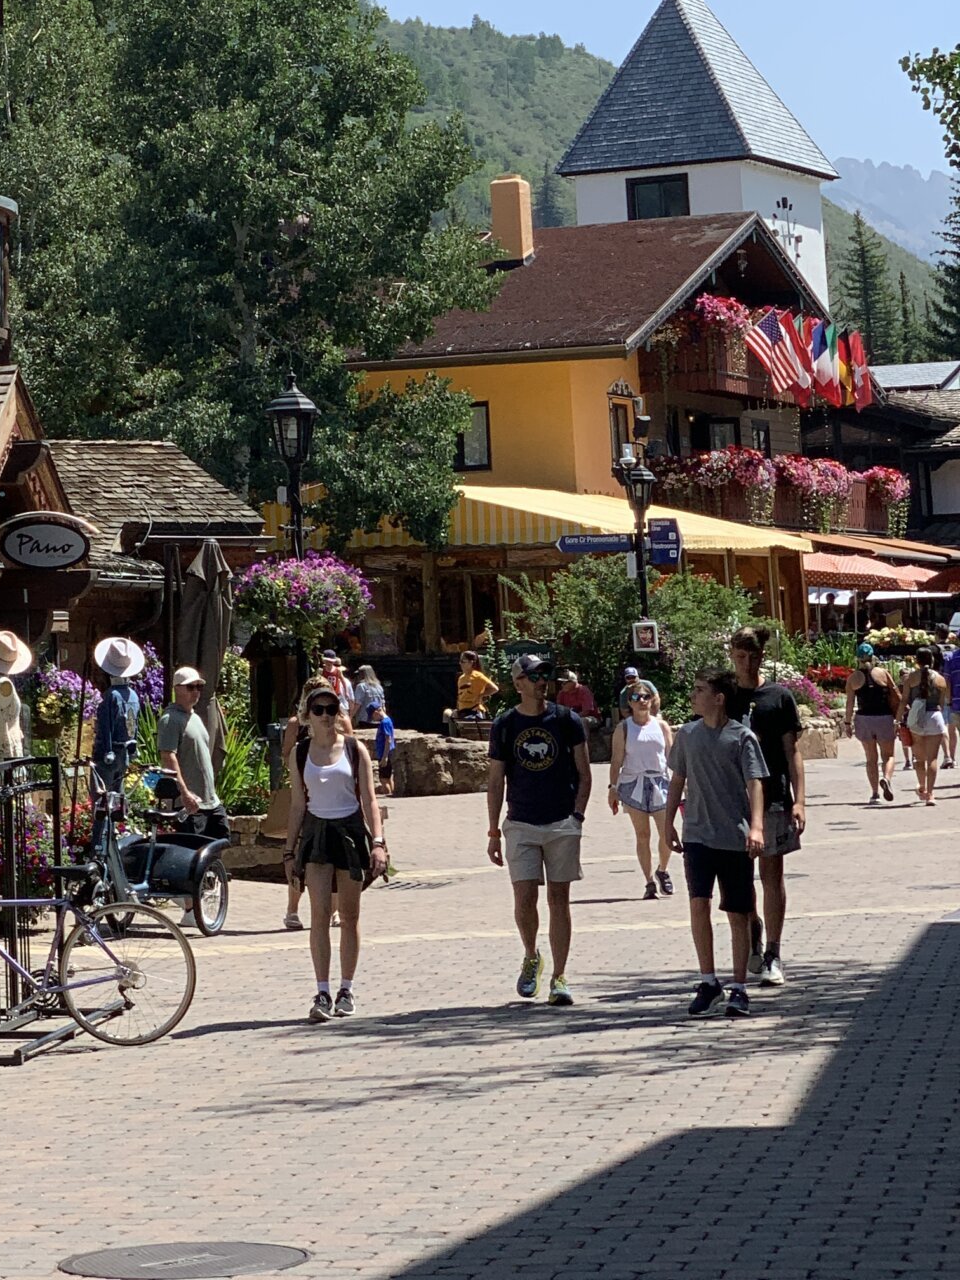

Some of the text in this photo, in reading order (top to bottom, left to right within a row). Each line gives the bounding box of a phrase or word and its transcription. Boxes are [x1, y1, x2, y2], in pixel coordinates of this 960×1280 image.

[16, 533, 74, 556] Pano
[564, 536, 578, 544] Gore
[587, 535, 619, 543] Promenade
[516, 729, 552, 746] MUSTANG
[521, 756, 552, 769] LOUNGE
